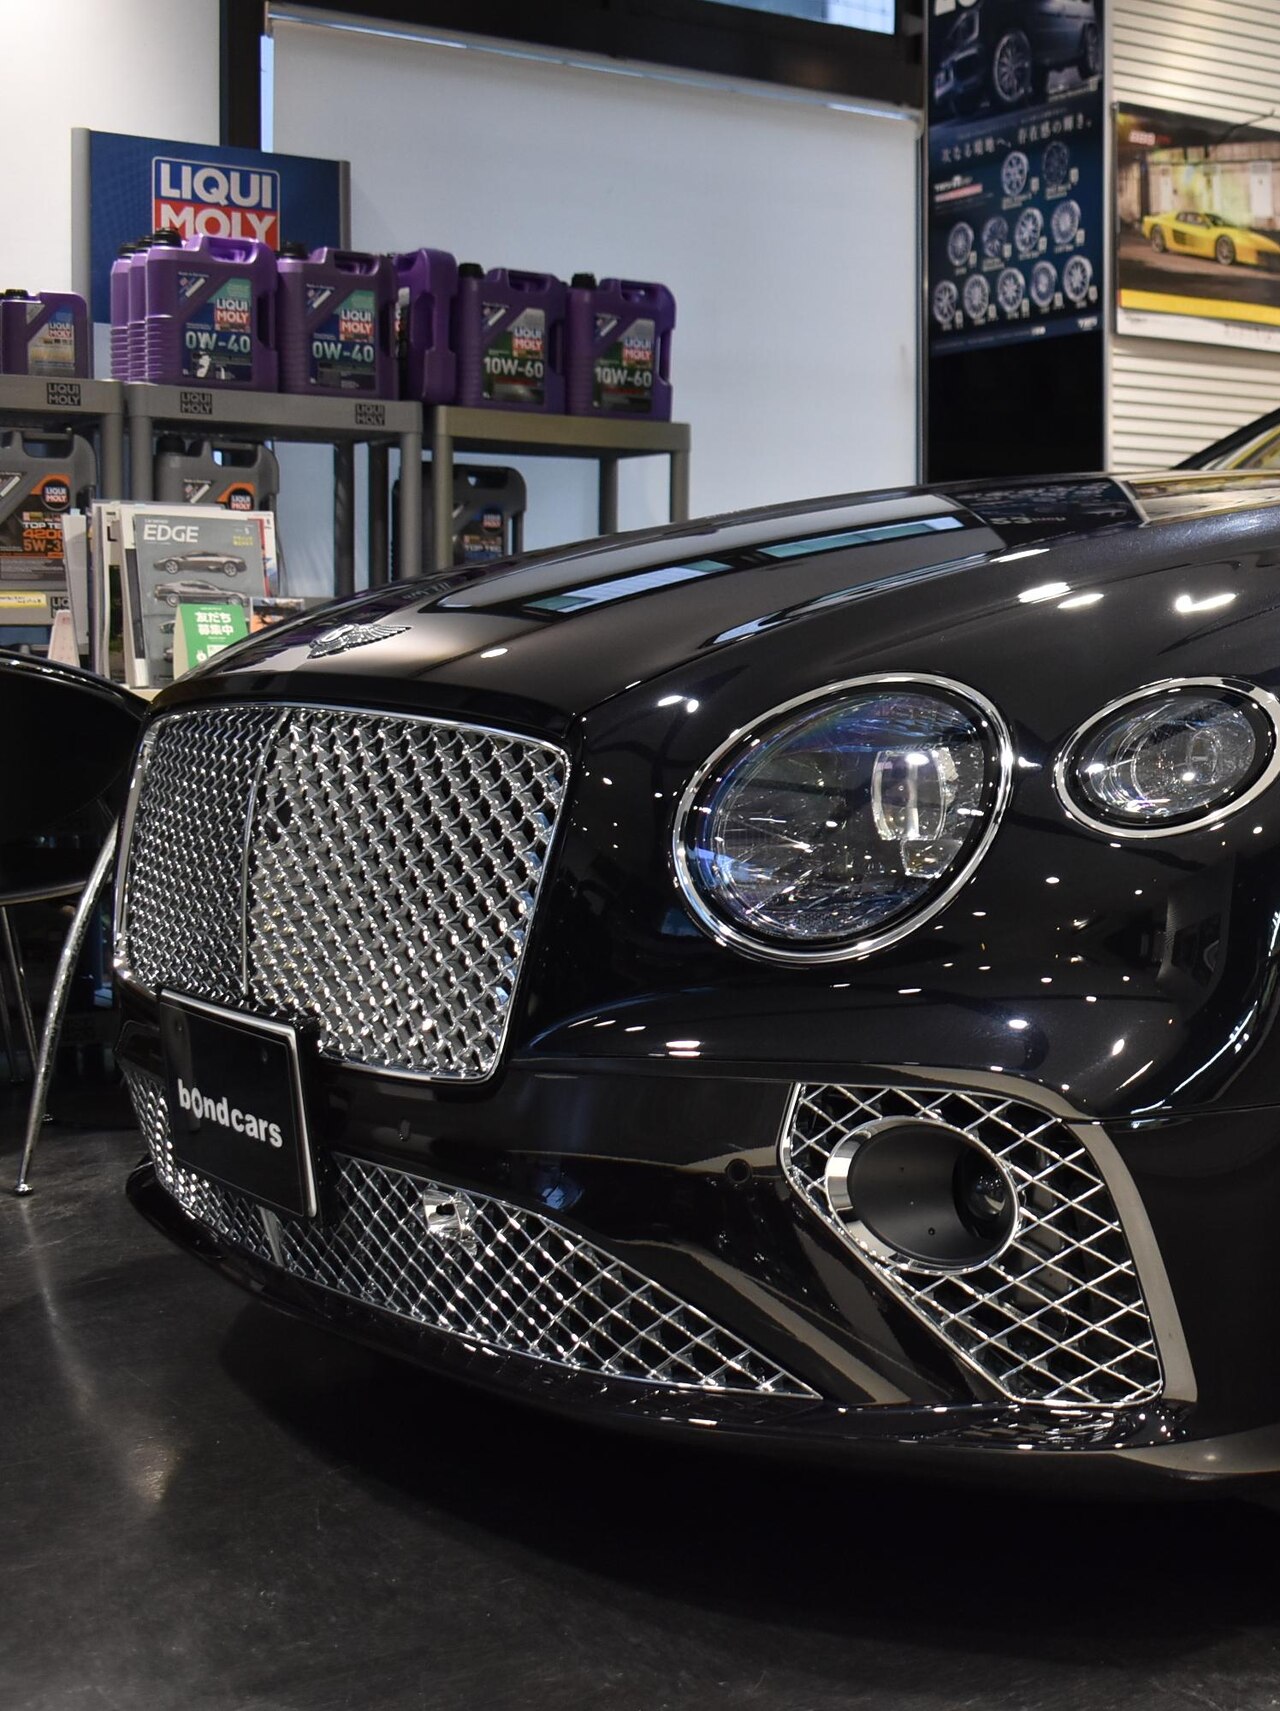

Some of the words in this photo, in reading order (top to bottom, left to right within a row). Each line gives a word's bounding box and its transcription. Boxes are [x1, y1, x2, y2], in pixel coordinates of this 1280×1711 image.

[160, 162, 273, 209] LIQUI
[161, 203, 276, 250] MOLY
[216, 299, 249, 312] LIQUI
[216, 309, 249, 323] MOLY
[341, 309, 373, 321] LIQUI
[341, 320, 373, 334] MOLY
[514, 328, 542, 339] LIQUI
[185, 331, 251, 353] 0W-40
[513, 337, 544, 351] MOLY
[624, 337, 652, 348] LIQUI
[312, 341, 375, 363] 0W-40
[623, 347, 653, 361] MOLY
[484, 356, 545, 379] 10W-60
[596, 366, 653, 387] 10W-60
[48, 383, 80, 394] LIQUI
[48, 393, 80, 405] MOLY
[181, 392, 212, 404] LIQUI
[181, 402, 213, 414] MOLY
[356, 404, 385, 415] LIQUI
[355, 414, 386, 426] MOLY
[45, 486, 67, 495] LIQUI
[45, 494, 68, 503] MOLY
[231, 494, 251, 503] LIQUI
[231, 502, 251, 510] MOLY
[143, 524, 200, 543] EDGE
[23, 540, 64, 552] 5W-3
